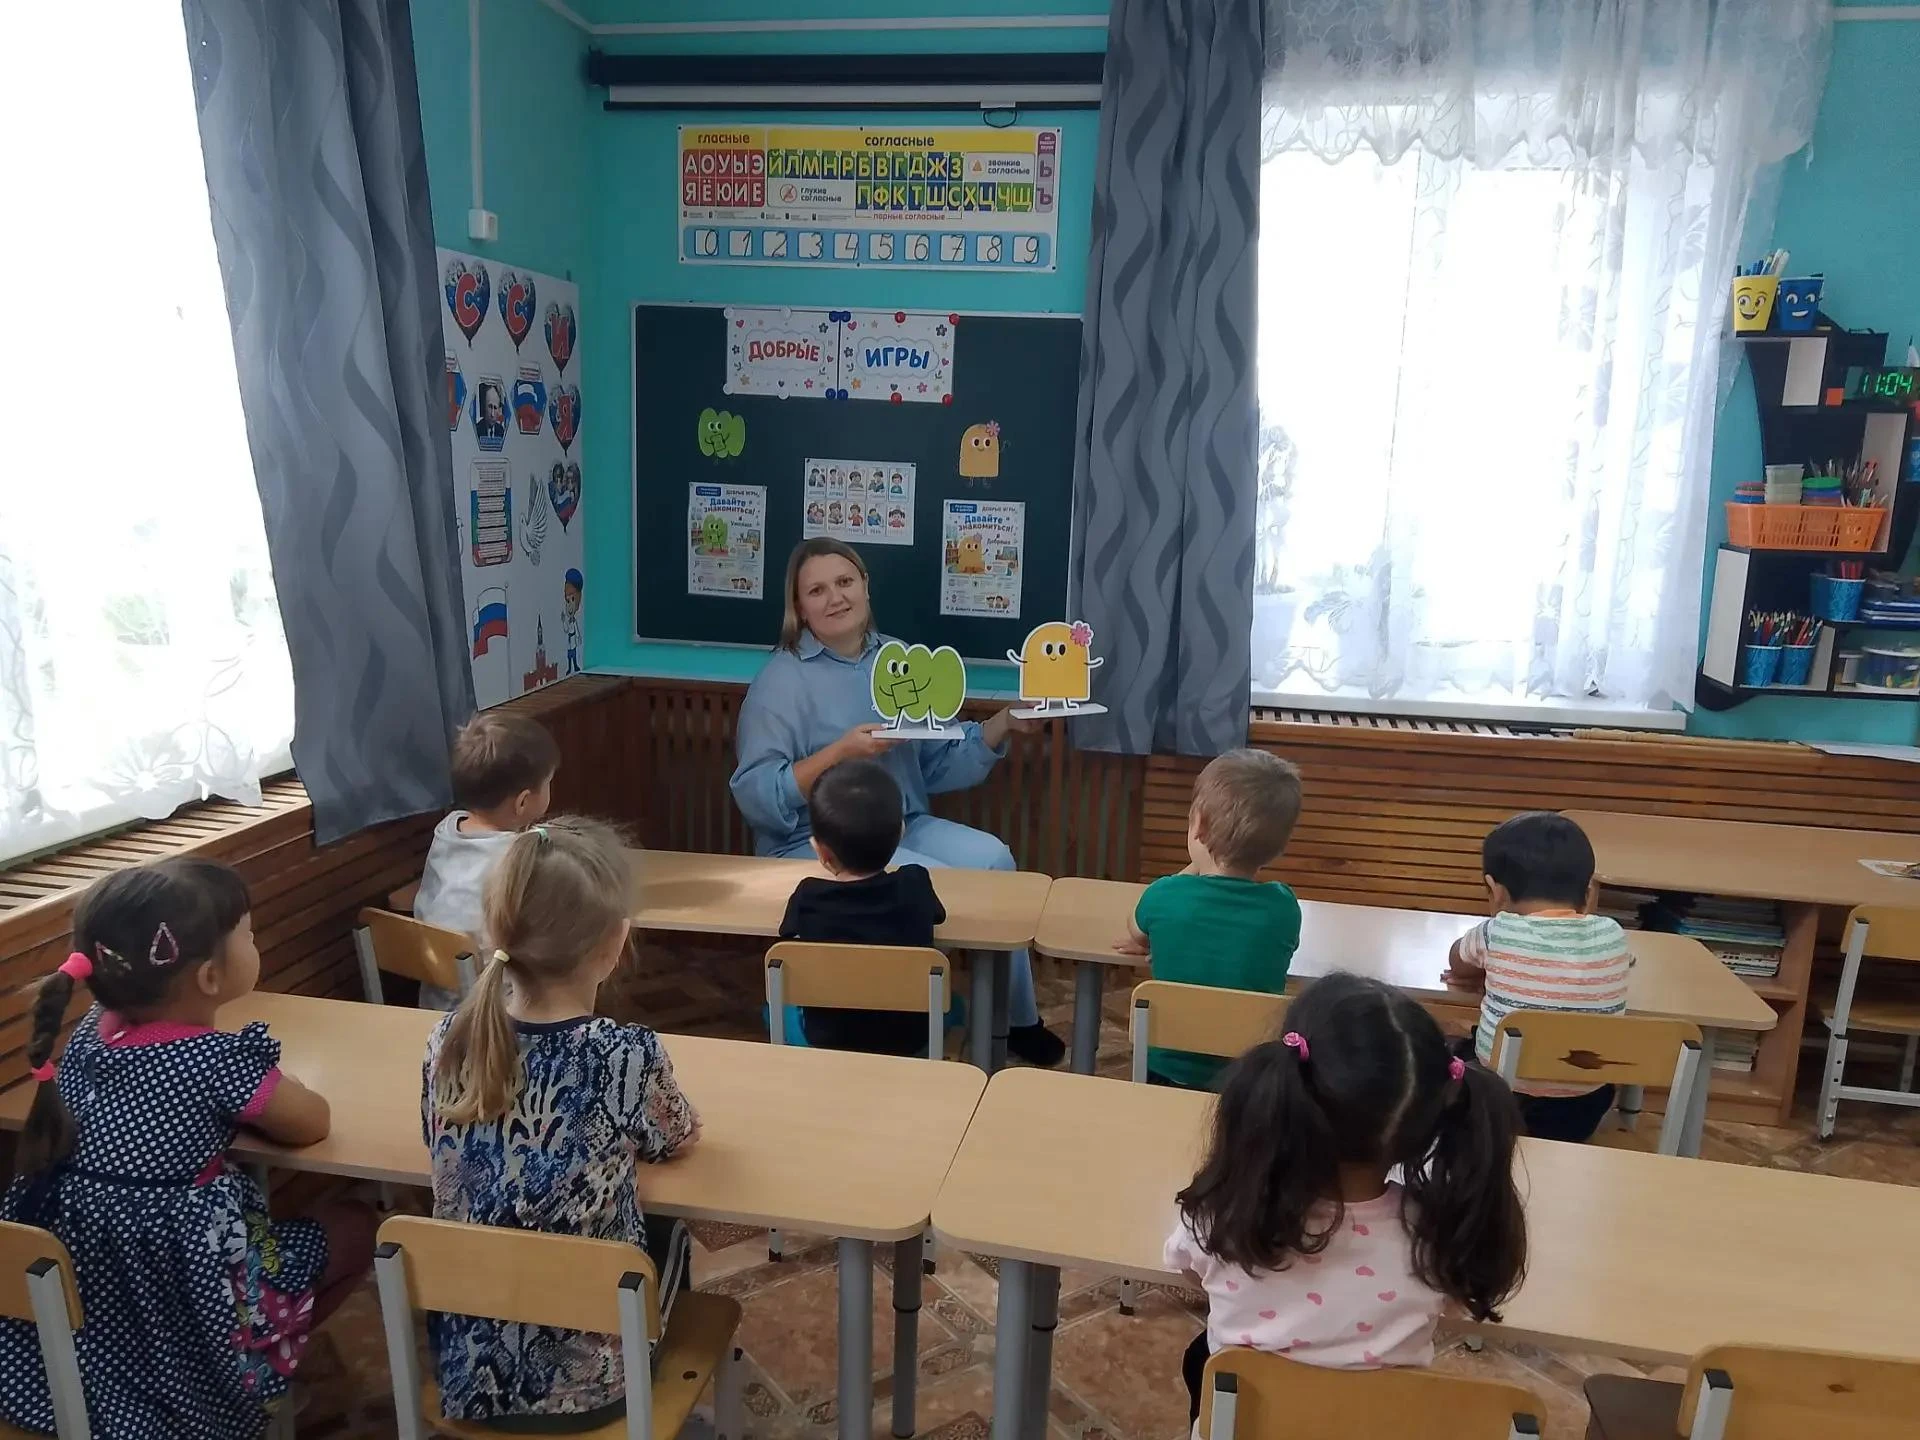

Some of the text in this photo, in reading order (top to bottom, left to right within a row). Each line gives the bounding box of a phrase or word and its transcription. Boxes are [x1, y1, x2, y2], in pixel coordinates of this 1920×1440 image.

[698, 134, 750, 145] гласные
[865, 135, 935, 147] согласные
[988, 167, 1030, 175] согласные
[800, 195, 842, 203] согласные
[705, 229, 719, 256] 0
[772, 231, 788, 258] 2
[809, 232, 823, 259] 3
[845, 233, 859, 260] 4
[878, 233, 894, 260] 5
[914, 234, 929, 261] 6
[951, 234, 965, 262] 7
[987, 235, 1001, 262] 8
[1024, 236, 1039, 263] 9
[455, 273, 573, 440] С С И Я
[748, 340, 930, 369] ДОБРЫЕ ИГРЫ
[1862, 372, 1913, 396] 11:04
[964, 515, 1003, 524] Давайте
